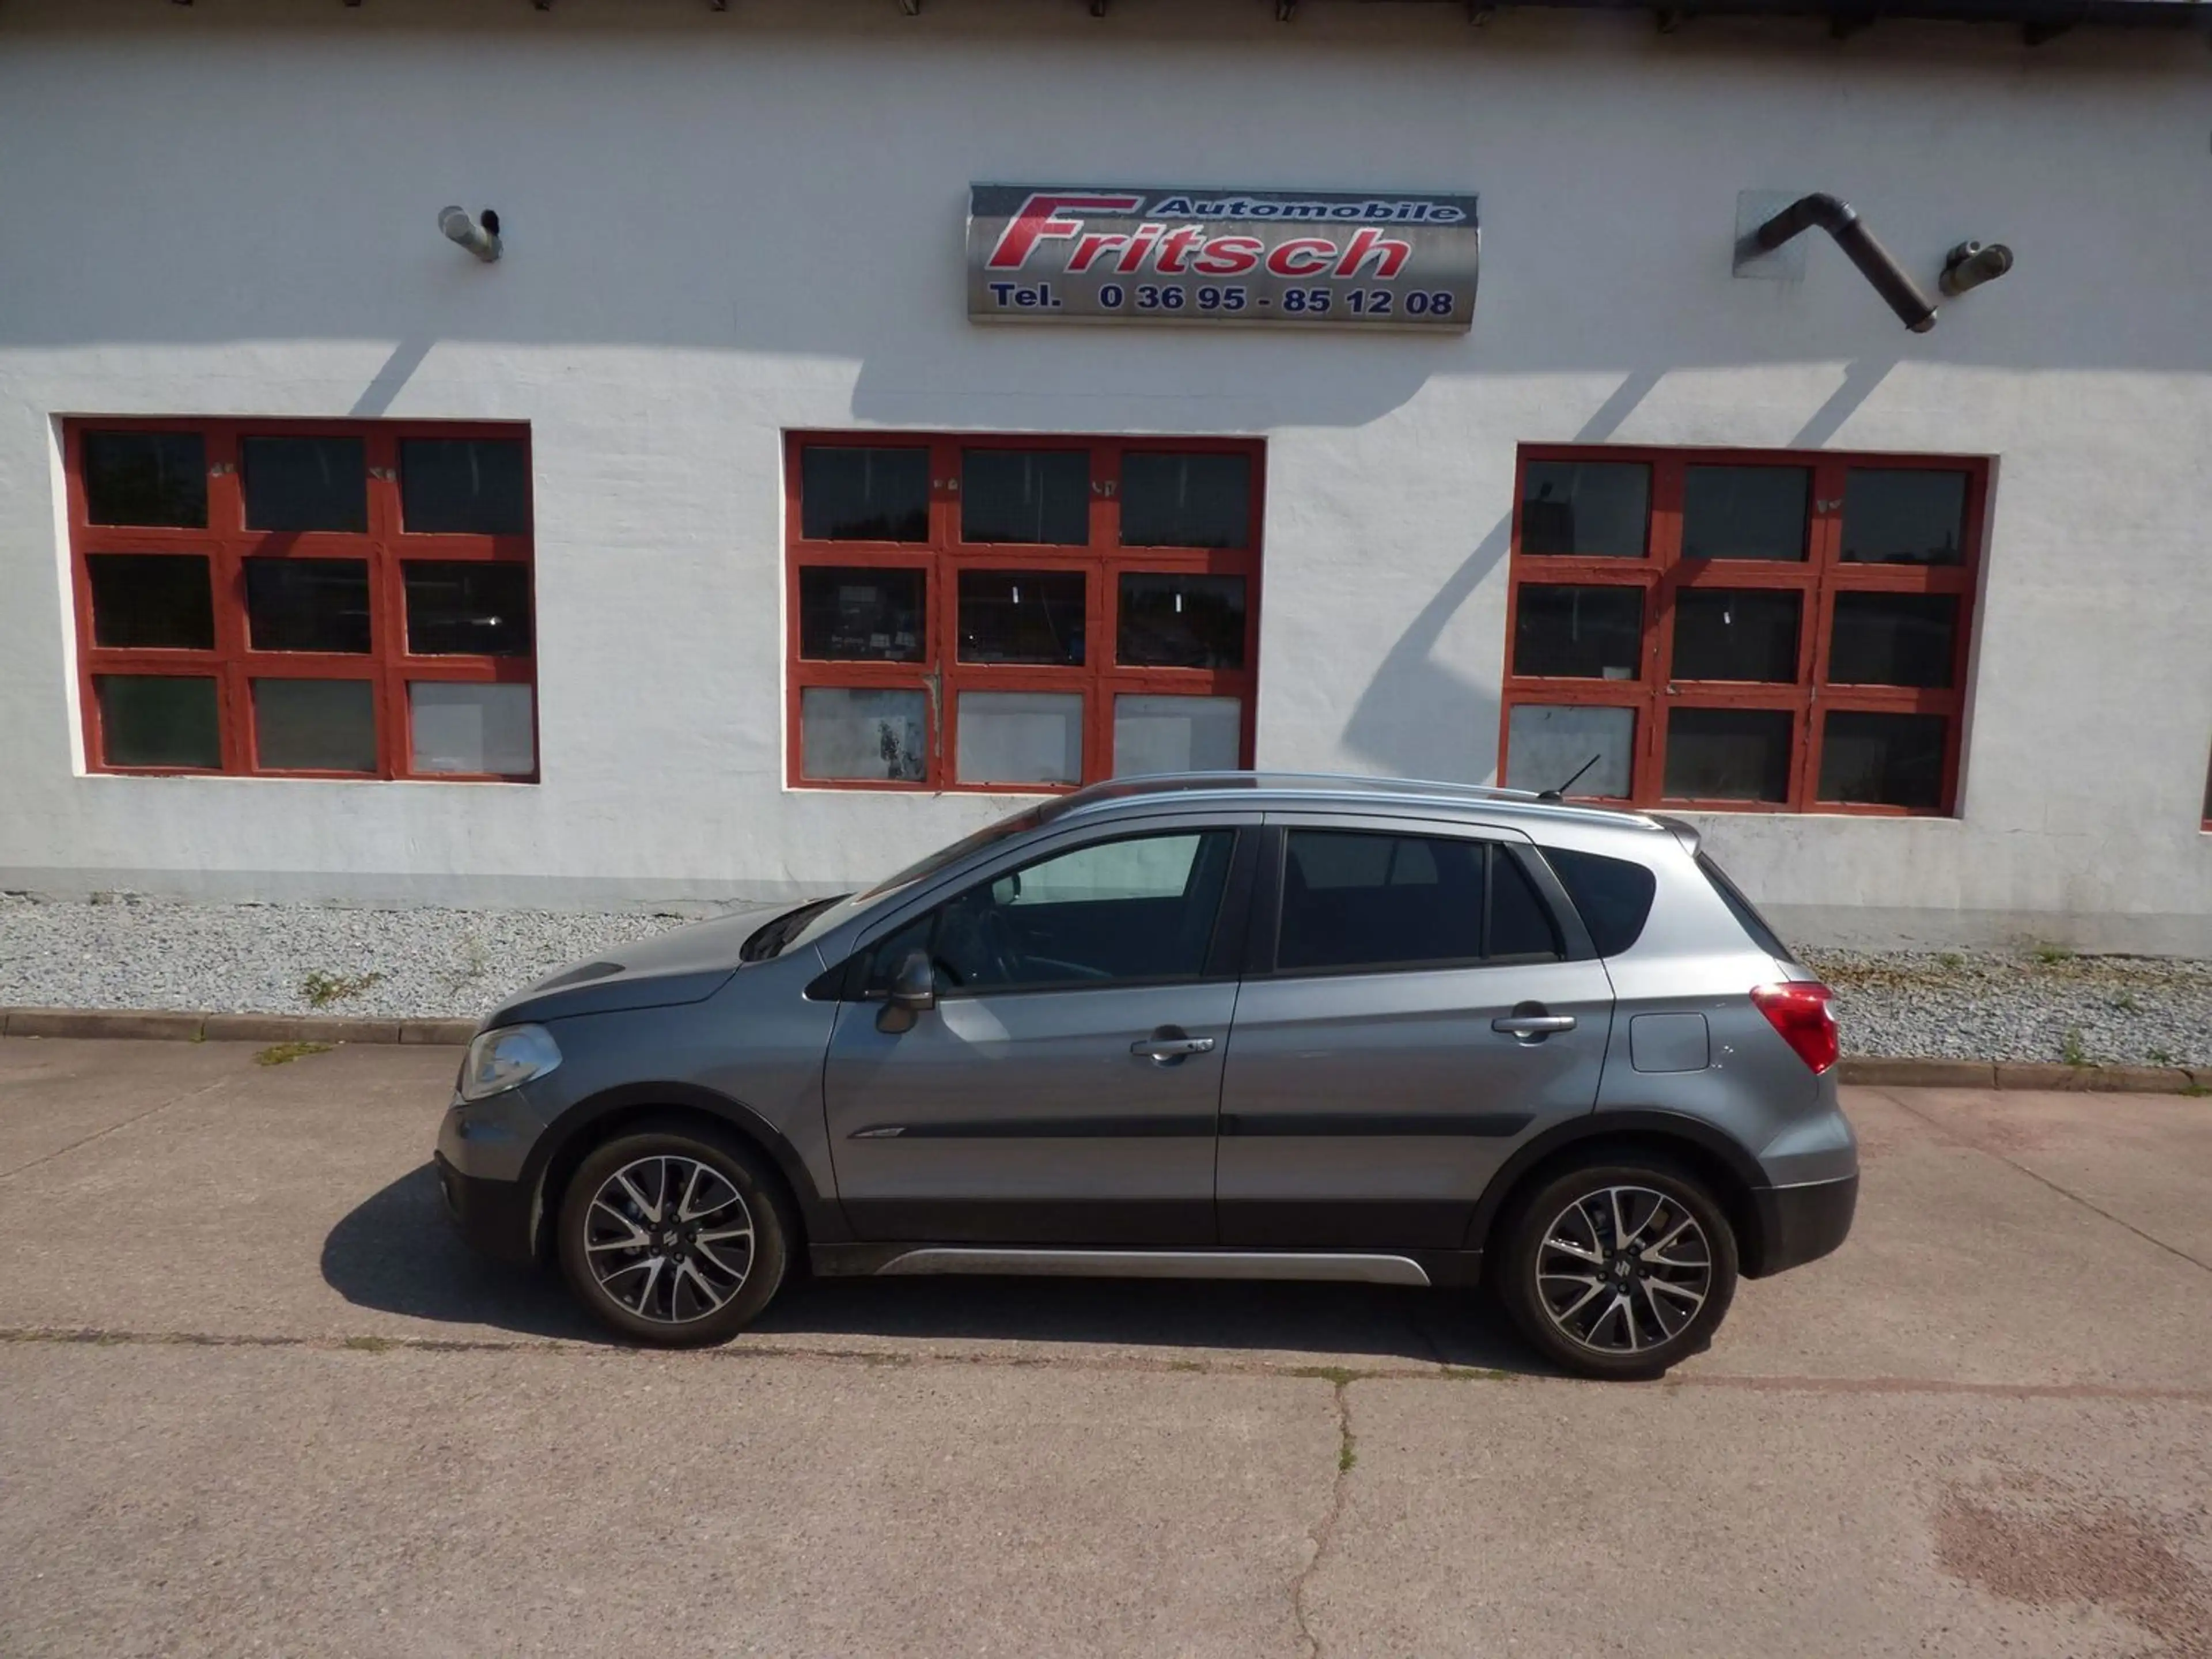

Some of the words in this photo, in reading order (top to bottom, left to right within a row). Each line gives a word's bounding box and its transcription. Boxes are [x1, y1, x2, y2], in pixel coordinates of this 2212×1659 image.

[1154, 196, 1462, 221] Automobile
[987, 194, 1411, 278] Fritsch
[990, 283, 1061, 306] Tel.
[1100, 285, 1123, 308] 0
[1136, 286, 1184, 309] 36
[1198, 287, 1245, 310] 95
[1283, 289, 1331, 312] 85
[1346, 290, 1393, 313] 12
[1406, 291, 1453, 315] 08
